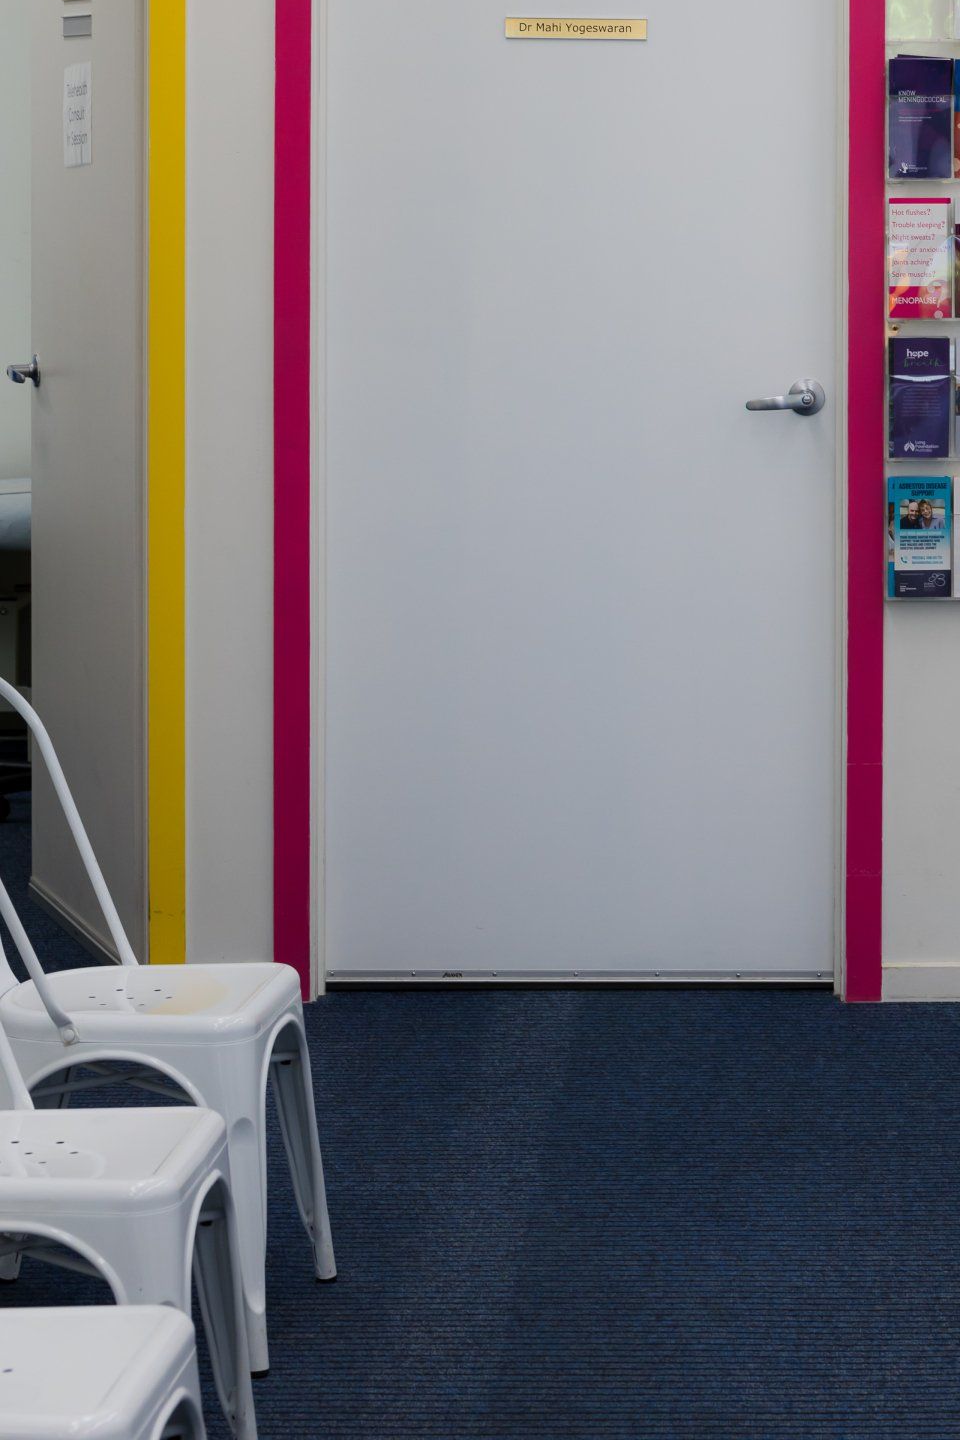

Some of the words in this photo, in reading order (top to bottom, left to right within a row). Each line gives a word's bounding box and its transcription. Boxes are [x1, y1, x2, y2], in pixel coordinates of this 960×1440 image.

[519, 23, 532, 32] Dr
[536, 23, 561, 32] Mahi
[566, 23, 632, 34] Yogeswaran
